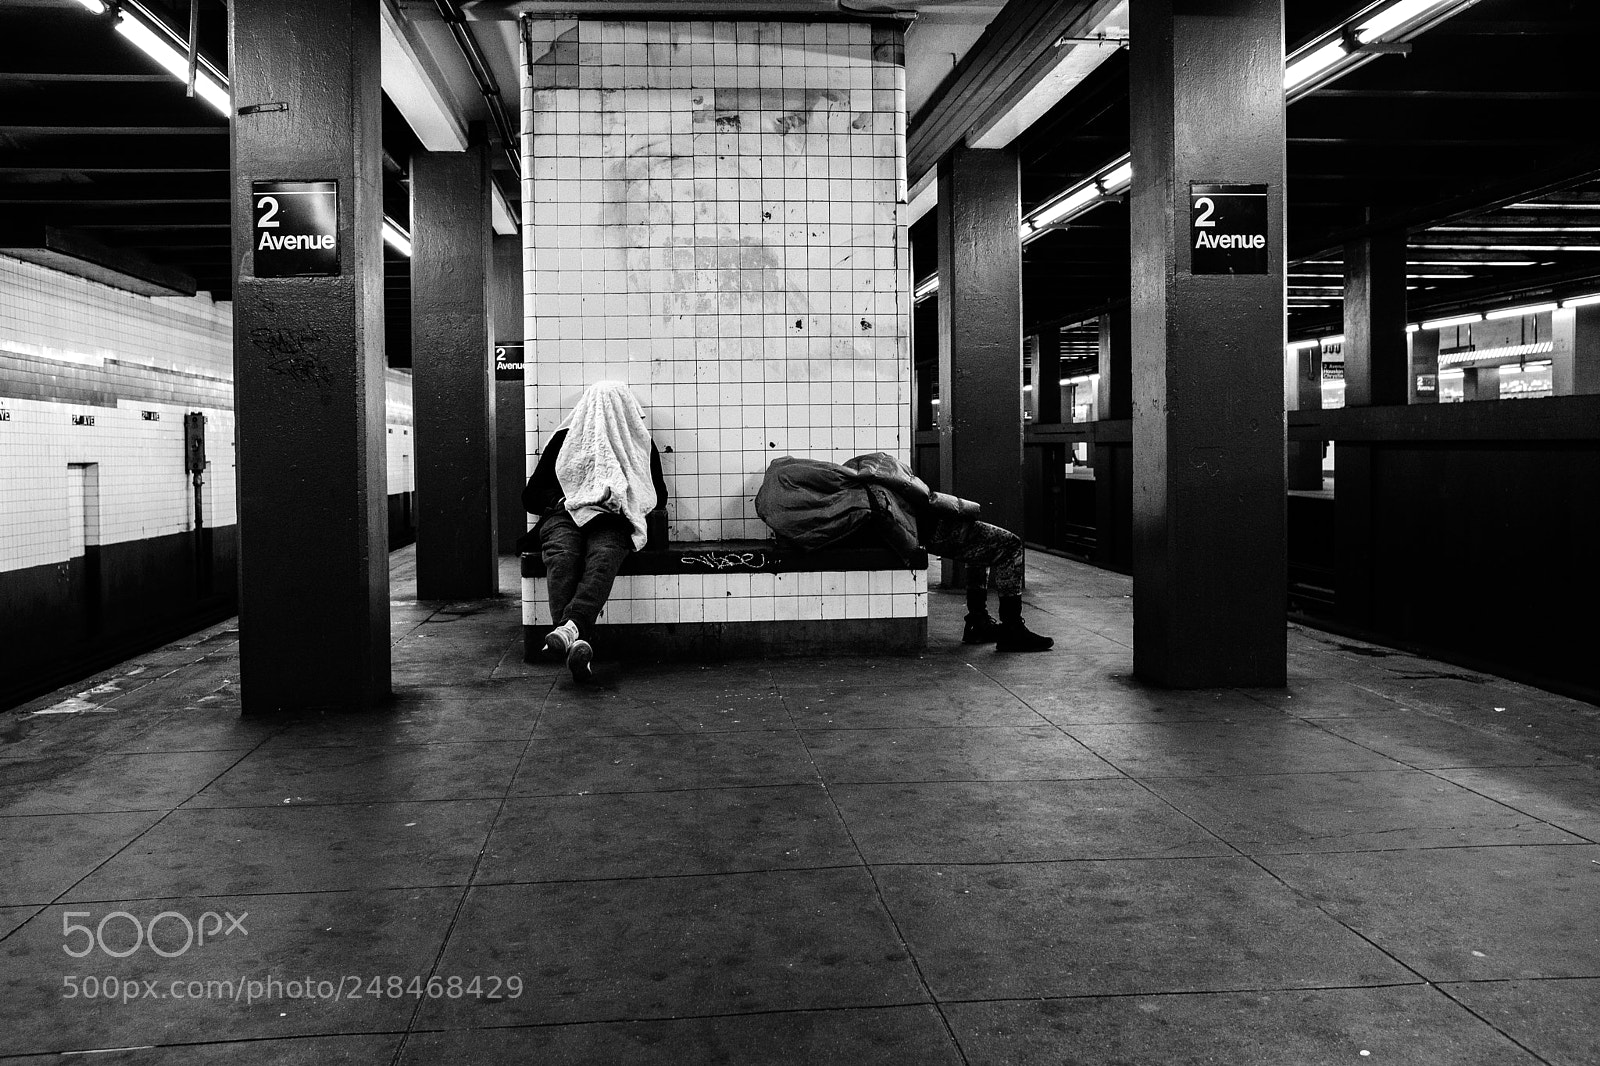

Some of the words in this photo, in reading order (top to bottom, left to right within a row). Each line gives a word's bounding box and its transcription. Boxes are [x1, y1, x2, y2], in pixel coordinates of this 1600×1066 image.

[257, 196, 280, 228] 2
[1194, 197, 1216, 227] 2
[258, 231, 336, 251] Avenue
[1195, 230, 1266, 249] Avenue
[496, 347, 506, 361] 2
